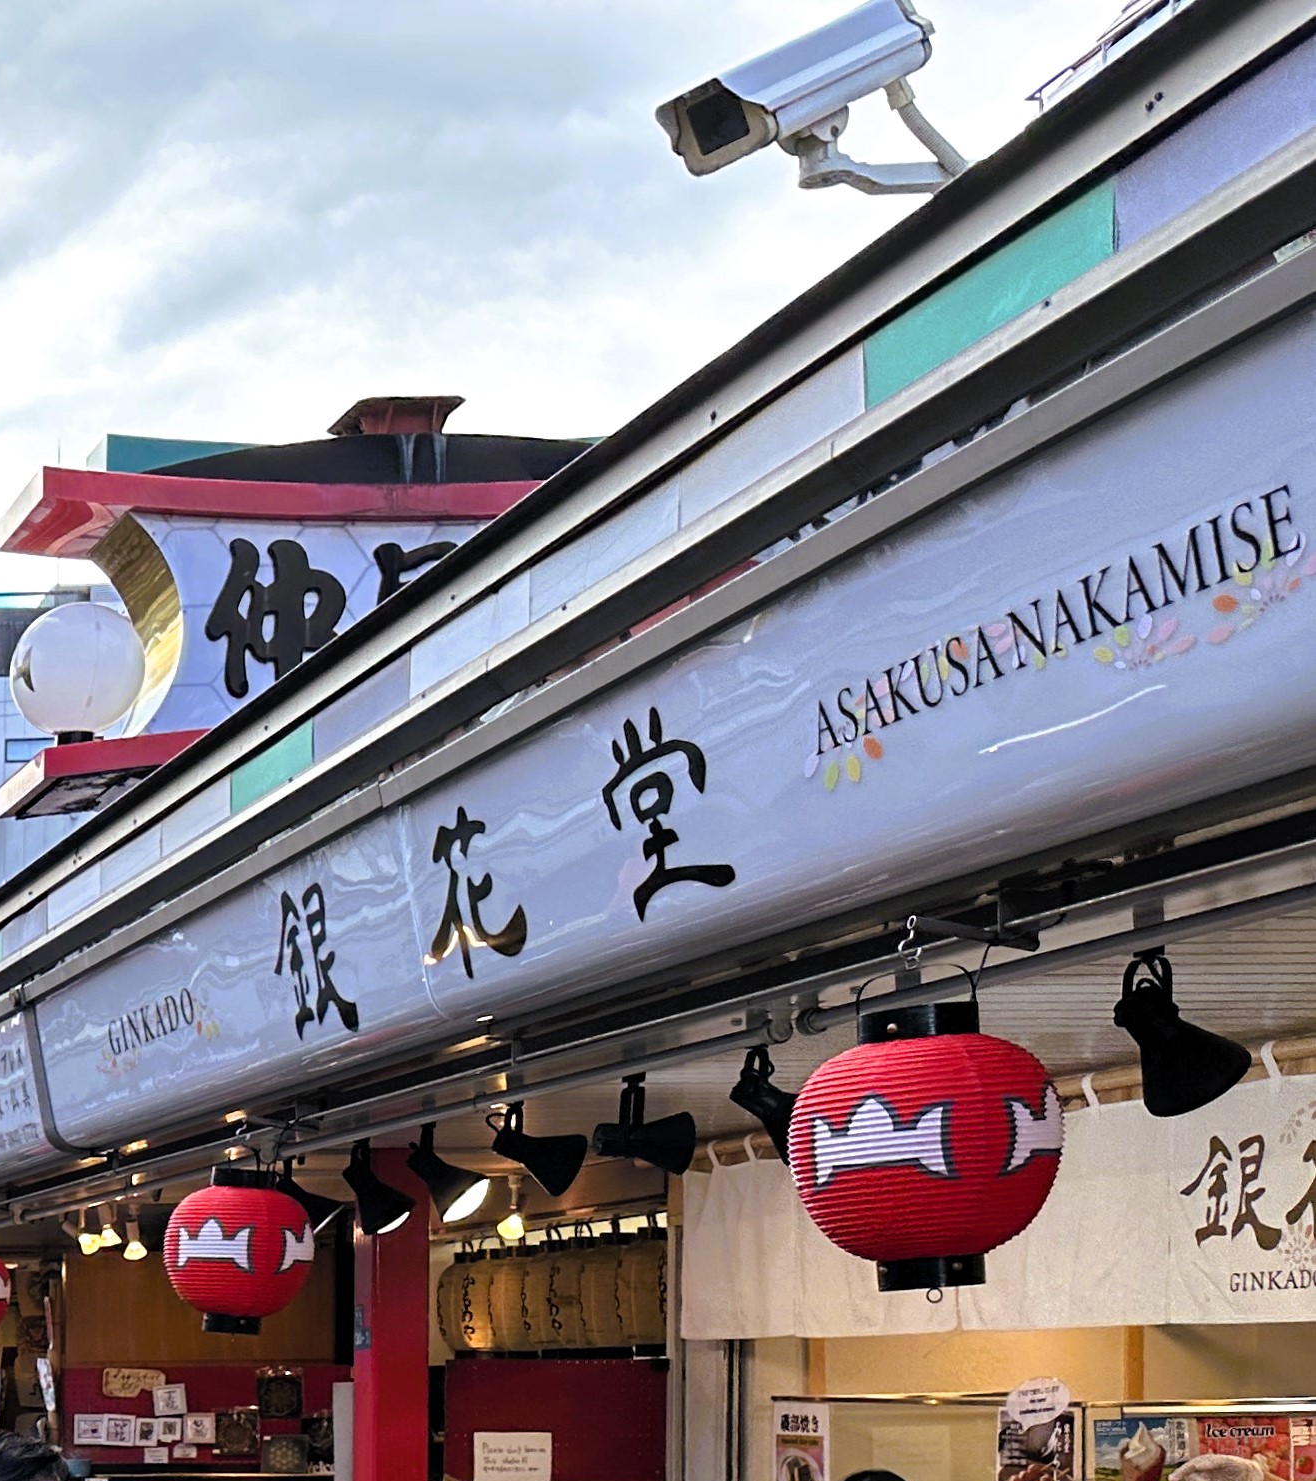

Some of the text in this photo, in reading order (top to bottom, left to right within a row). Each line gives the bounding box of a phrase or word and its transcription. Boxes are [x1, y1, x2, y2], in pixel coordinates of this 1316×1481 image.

[814, 484, 1302, 756] ASAKUSA NAKAMISE
[274, 706, 737, 1042] 銀花堂
[108, 987, 195, 1056] GINKADO
[1205, 1423, 1277, 1439] Ice cream
